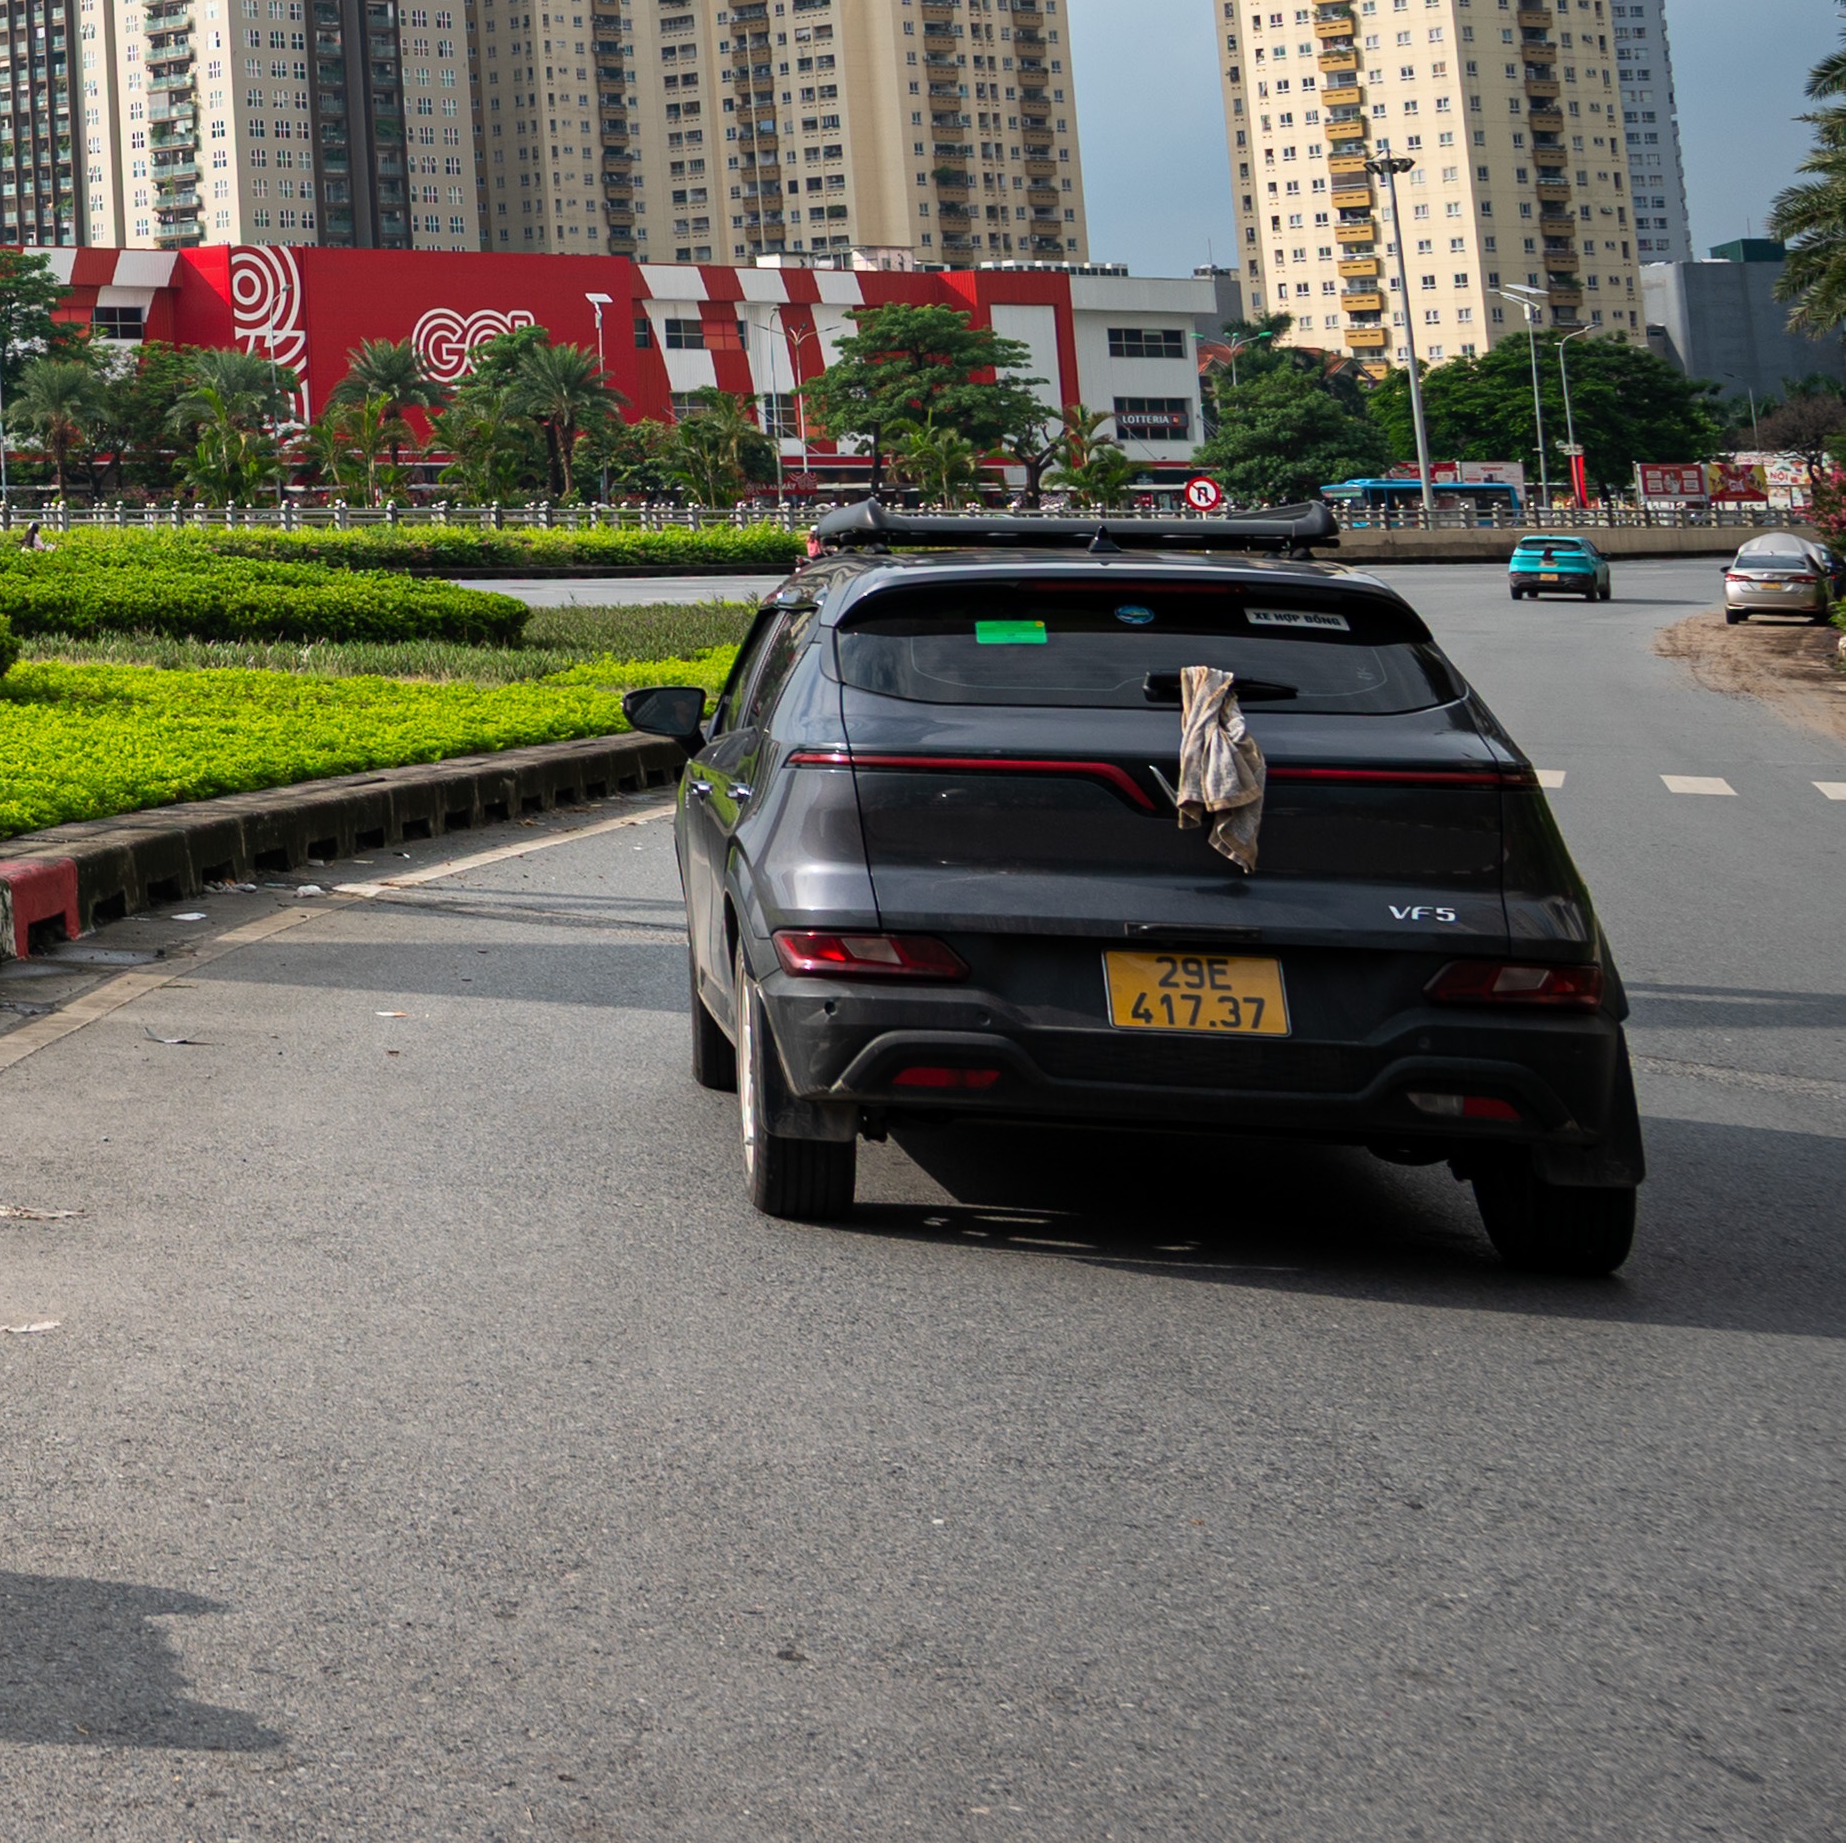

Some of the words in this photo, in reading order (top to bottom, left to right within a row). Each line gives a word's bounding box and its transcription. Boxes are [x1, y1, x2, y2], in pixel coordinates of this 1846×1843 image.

[1122, 415, 1169, 424] LOTTERIA
[1155, 957, 1232, 991] 29E
[1132, 992, 1266, 1030] 417.37
